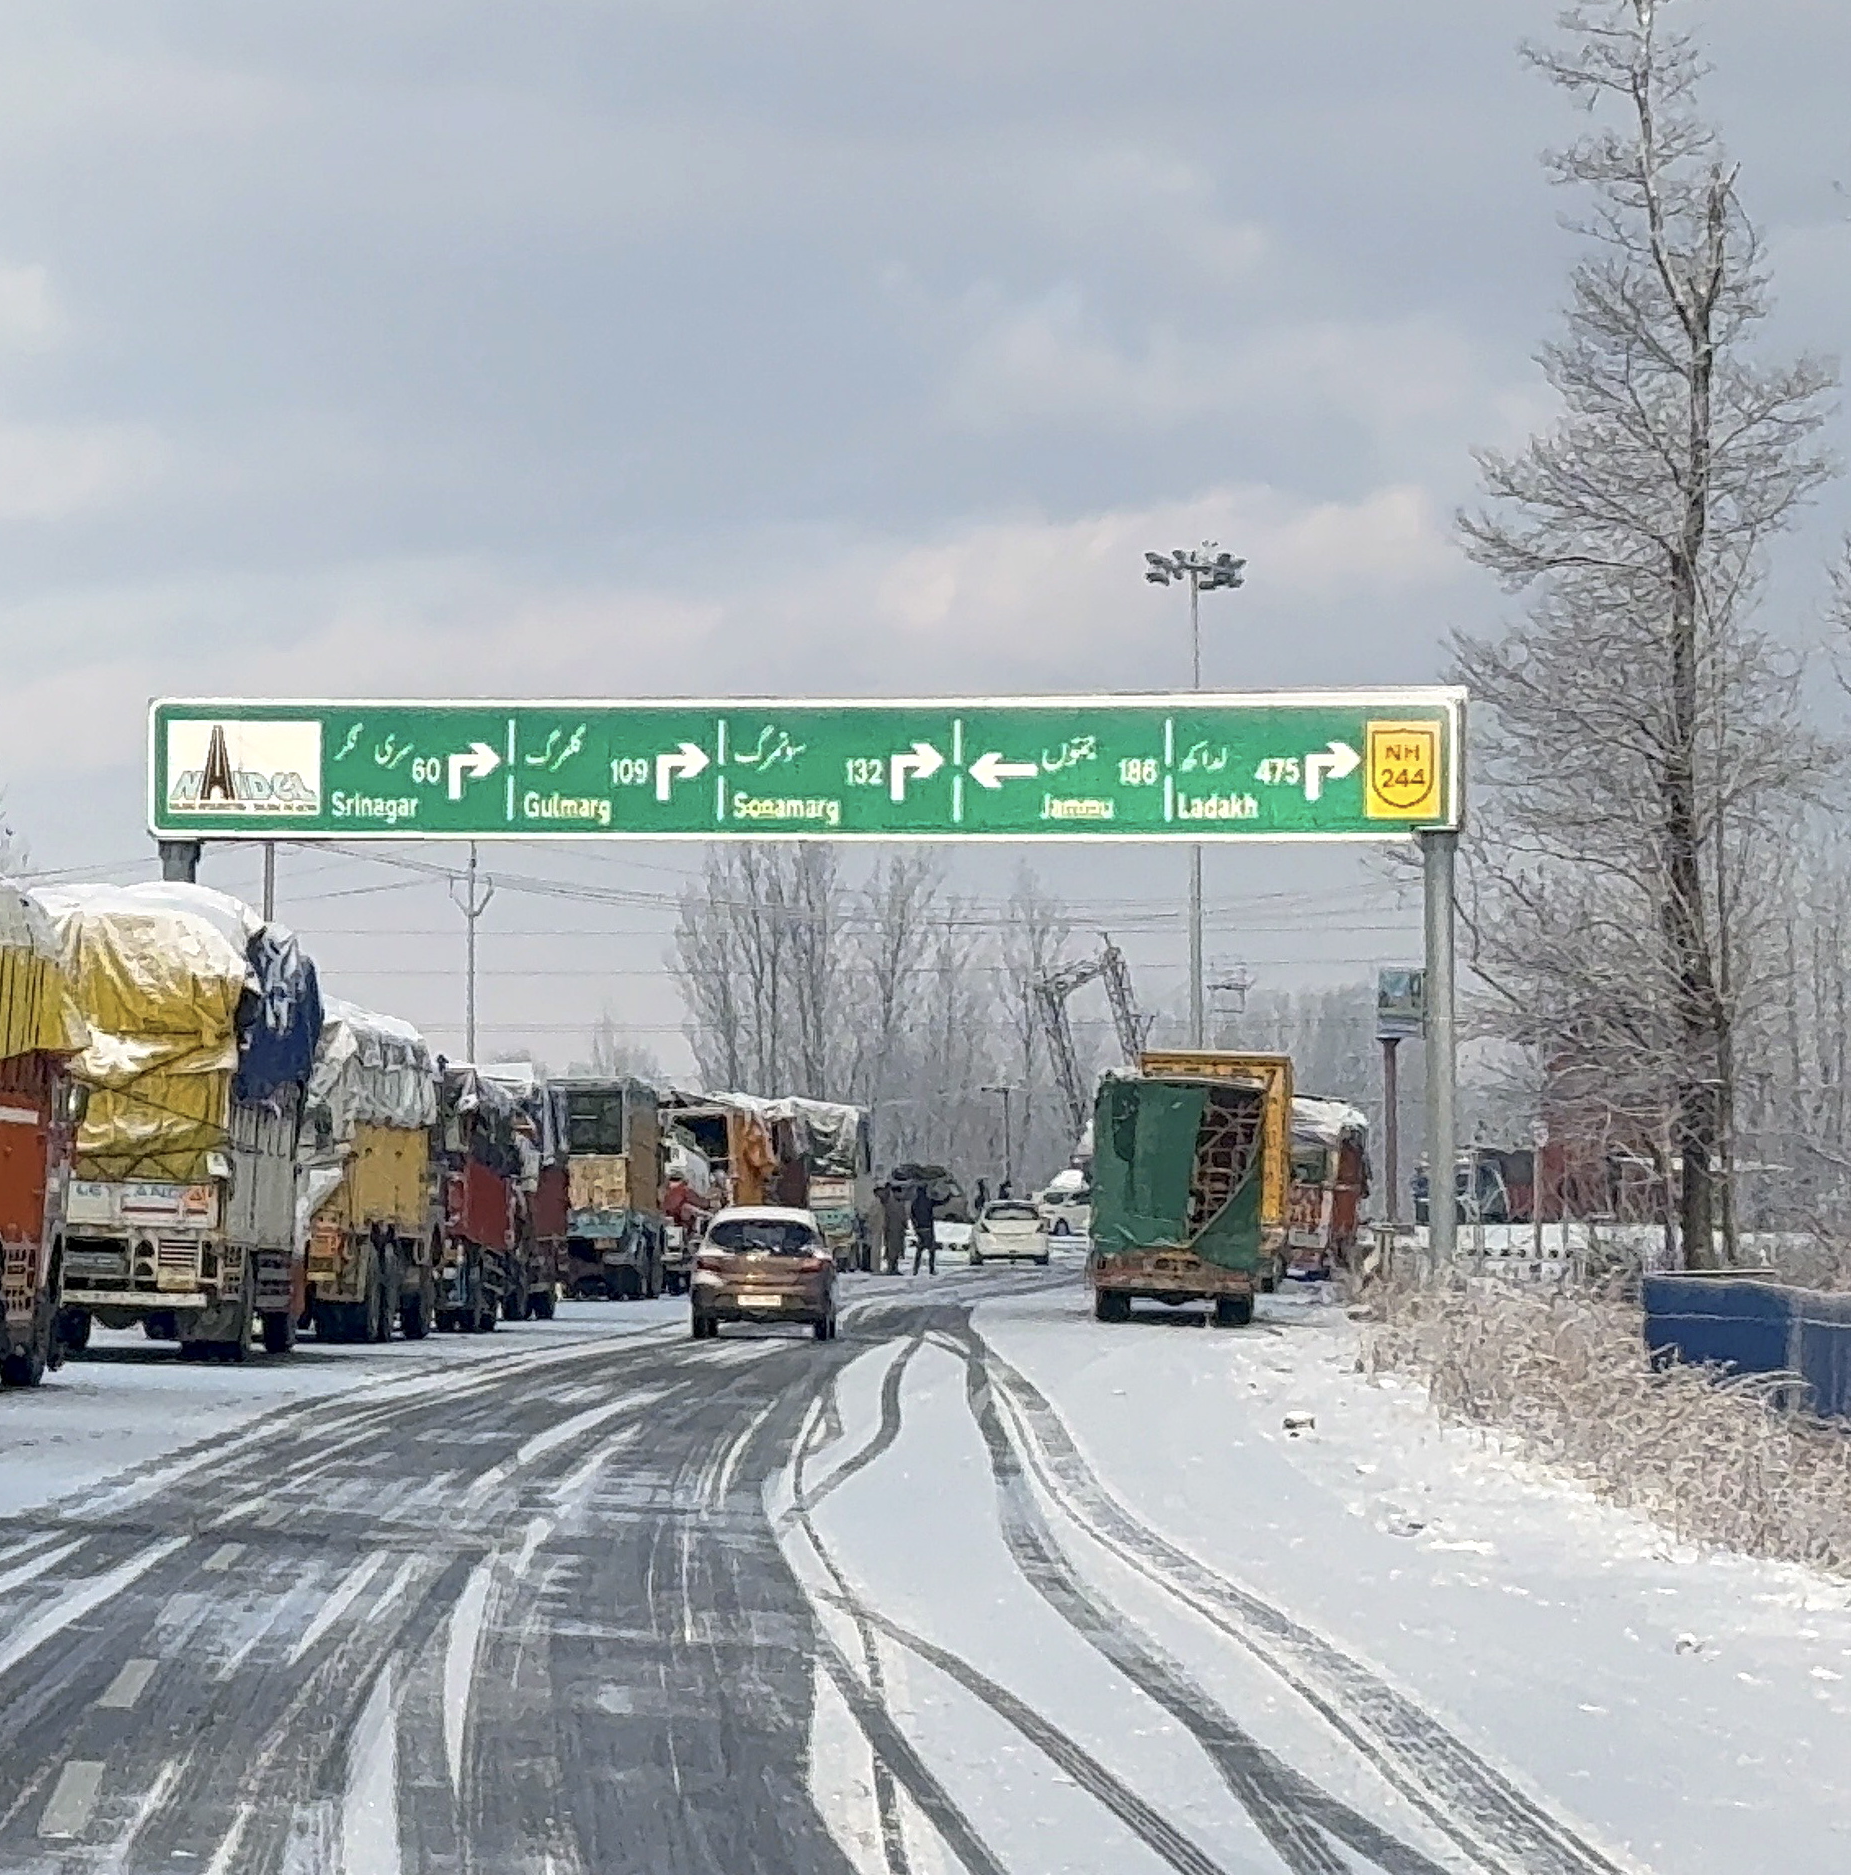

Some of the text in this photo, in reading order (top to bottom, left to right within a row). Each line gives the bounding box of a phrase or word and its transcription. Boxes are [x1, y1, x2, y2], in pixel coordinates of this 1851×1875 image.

[1385, 744, 1420, 761] NH
[412, 757, 441, 783] 60
[610, 758, 649, 784] 109
[846, 757, 884, 785] 132
[1118, 757, 1157, 785] 186
[1254, 757, 1300, 786] 475
[1381, 768, 1426, 788] 244
[331, 790, 419, 824] Srinagar
[523, 790, 612, 826] Gulmarg
[732, 790, 842, 827] Sonamarg
[1039, 792, 1115, 820] Jammu
[1176, 791, 1259, 820] Ladakh
